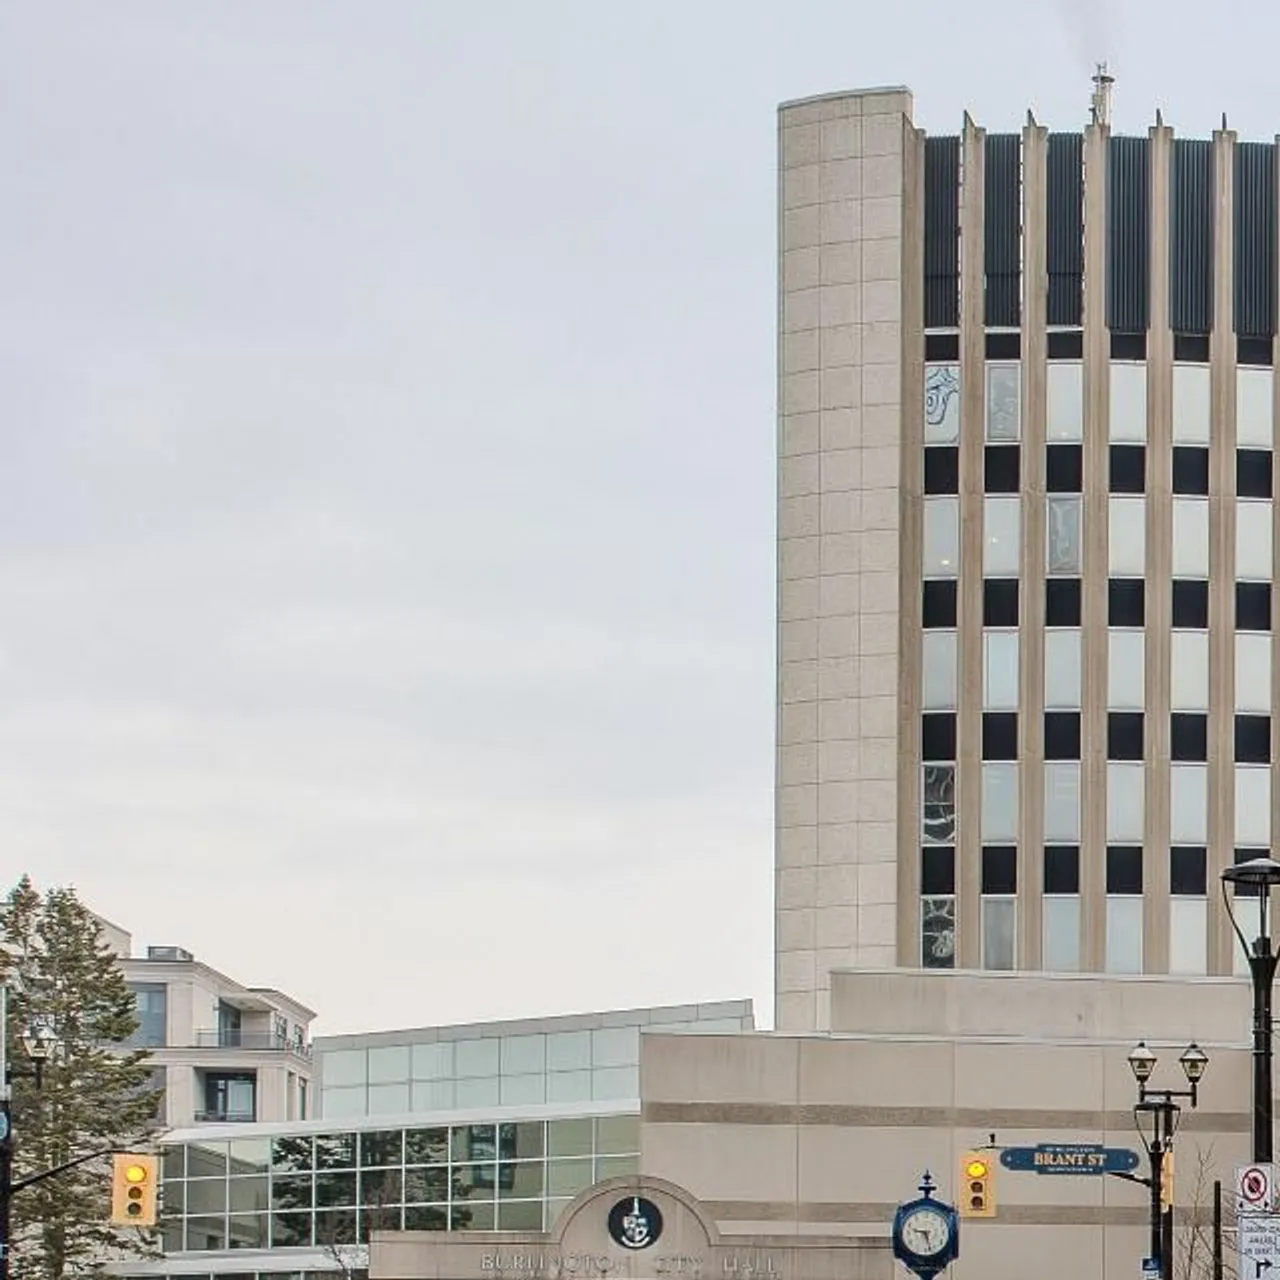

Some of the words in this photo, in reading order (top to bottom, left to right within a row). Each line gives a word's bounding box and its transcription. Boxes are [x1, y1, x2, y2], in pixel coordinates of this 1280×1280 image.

[1034, 1152, 1085, 1166] BRANT
[1087, 1153, 1107, 1167] ST
[481, 1252, 631, 1274] BURLINGTON
[655, 1254, 704, 1275] CITY
[722, 1255, 780, 1277] HALL
